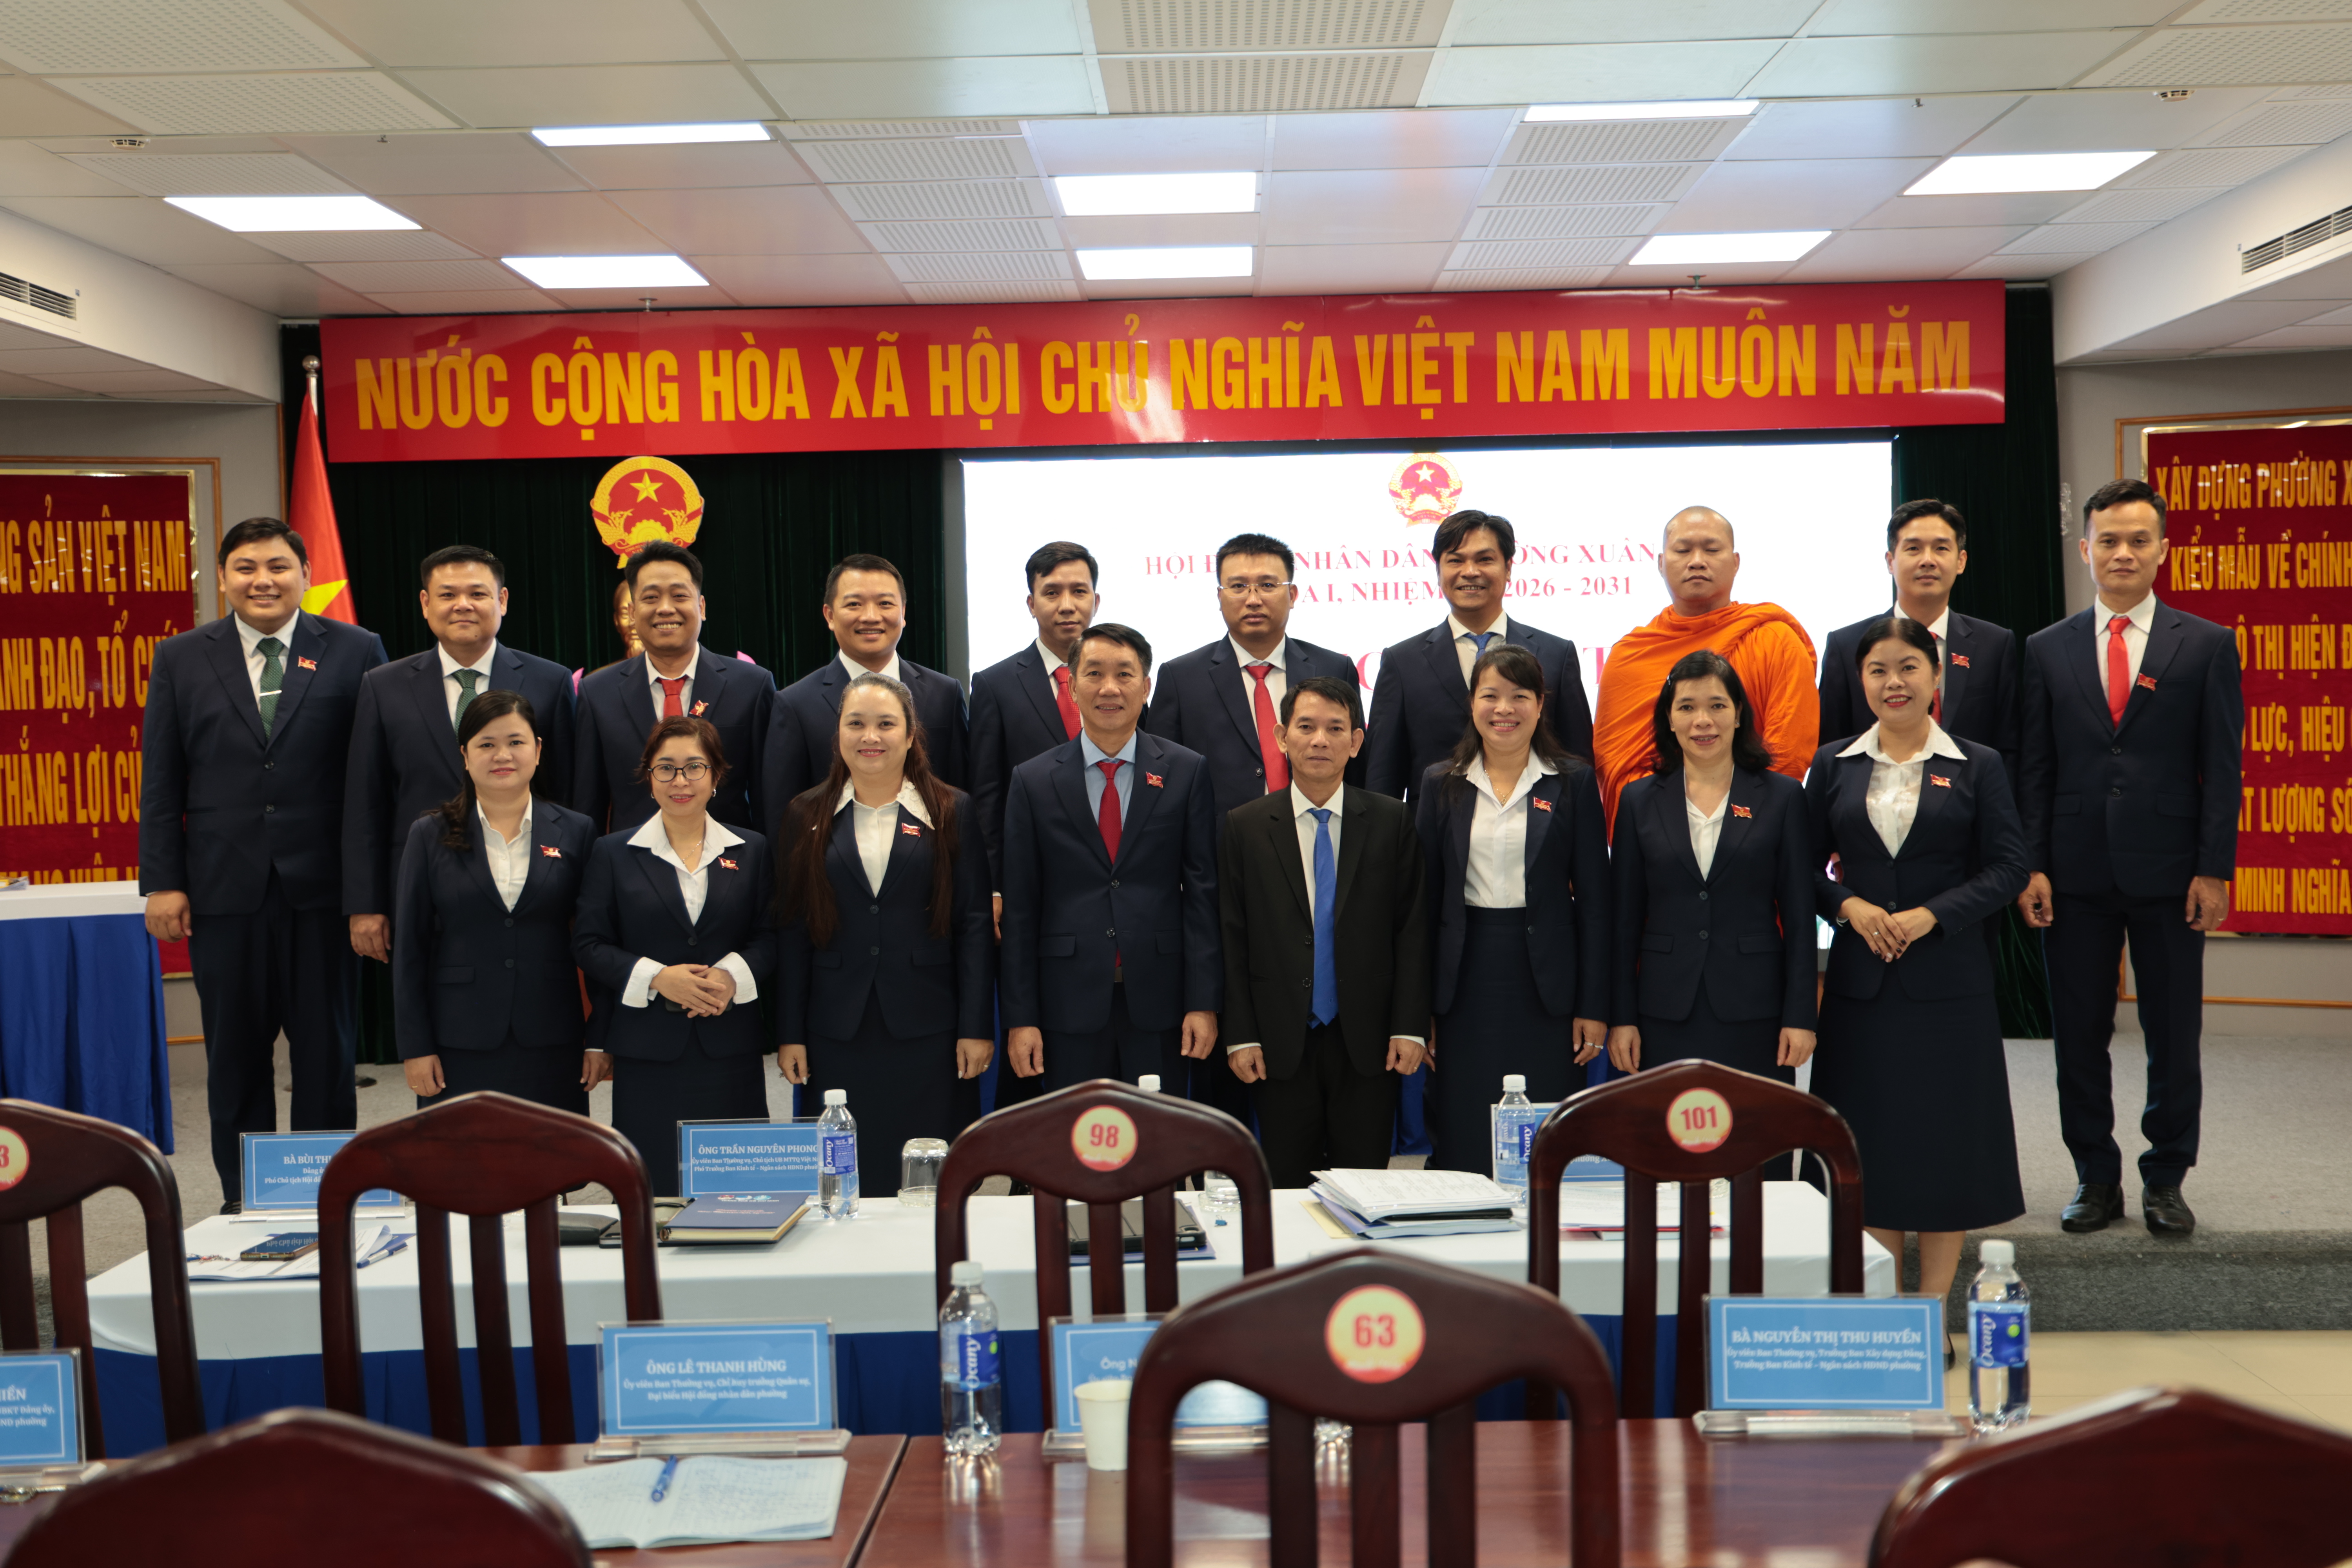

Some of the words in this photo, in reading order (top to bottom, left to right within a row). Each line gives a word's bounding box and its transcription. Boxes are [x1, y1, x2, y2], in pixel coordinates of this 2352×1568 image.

[357, 335, 509, 430] NƯỚC
[532, 336, 680, 441] CỘNG
[699, 332, 811, 422] HÒA
[829, 331, 909, 419] XÃ
[929, 327, 1020, 430] HỘI
[1040, 313, 1149, 414] CHỦ
[1169, 321, 1343, 410] NGHĨA
[1355, 316, 1474, 420] VIỆT
[1497, 328, 1630, 403] NAM
[1649, 307, 1816, 399] MUÔN
[1837, 305, 1971, 395] NĂM
[2156, 456, 2192, 511] XÂY
[2198, 460, 2252, 521] DỰNG
[2257, 450, 2337, 508] PHƯỜNG
[28, 494, 75, 594] SẢN
[78, 505, 127, 605] VIỆT
[133, 520, 187, 592] NAM
[1145, 552, 1195, 579] HỘI
[1294, 544, 1371, 570] NHÂN
[1512, 540, 1569, 565] ỜNG
[1578, 537, 1655, 563] XUÂN
[2171, 525, 2214, 591] KIỂU
[2218, 527, 2260, 590] MẪU
[2267, 529, 2291, 589] VỀ
[1351, 578, 1445, 605] NHIỆM
[1503, 578, 1555, 597] 2026
[1580, 576, 1631, 595] 2031
[0, 638, 36, 710] NH
[40, 636, 95, 724] ĐẠO,
[97, 610, 128, 708] TỔ
[2252, 625, 2285, 680] THỊ
[2290, 613, 2336, 680] HIỆN
[2251, 702, 2294, 763] LỰC,
[2301, 695, 2345, 762] HIỆU
[73, 744, 111, 838] LỢI
[114, 725, 143, 823] CỦ
[2260, 783, 2325, 843] LƯỢNG
[2235, 867, 2285, 913] MINH
[2292, 858, 2352, 915] NGHĨA
[1090, 1123, 1120, 1148] 98
[1681, 1105, 1718, 1131] 101
[283, 1154, 297, 1165] BÀ
[298, 1153, 314, 1164] BÙI
[698, 1144, 718, 1154] ÔNG
[720, 1143, 745, 1154] TRẦN
[747, 1143, 785, 1154] NGUYÊN
[787, 1145, 818, 1153] PHONG
[1354, 1314, 1396, 1348] 63
[1732, 1326, 1752, 1343] BÀ
[1753, 1325, 1811, 1343] NGUYỄN
[1813, 1330, 1838, 1347] THỊ
[1840, 1330, 1871, 1344] THU
[1982, 1313, 1996, 1367] Ocany
[646, 1359, 676, 1375] ÔNG
[677, 1357, 695, 1374] LÊ
[696, 1360, 745, 1374] THANH
[747, 1356, 787, 1372] HÙNG
[654, 1380, 670, 1388] Ban
[965, 1336, 981, 1389] Ocany
[1100, 1356, 1127, 1372] Ông
[0, 1384, 27, 1401] IỀN
